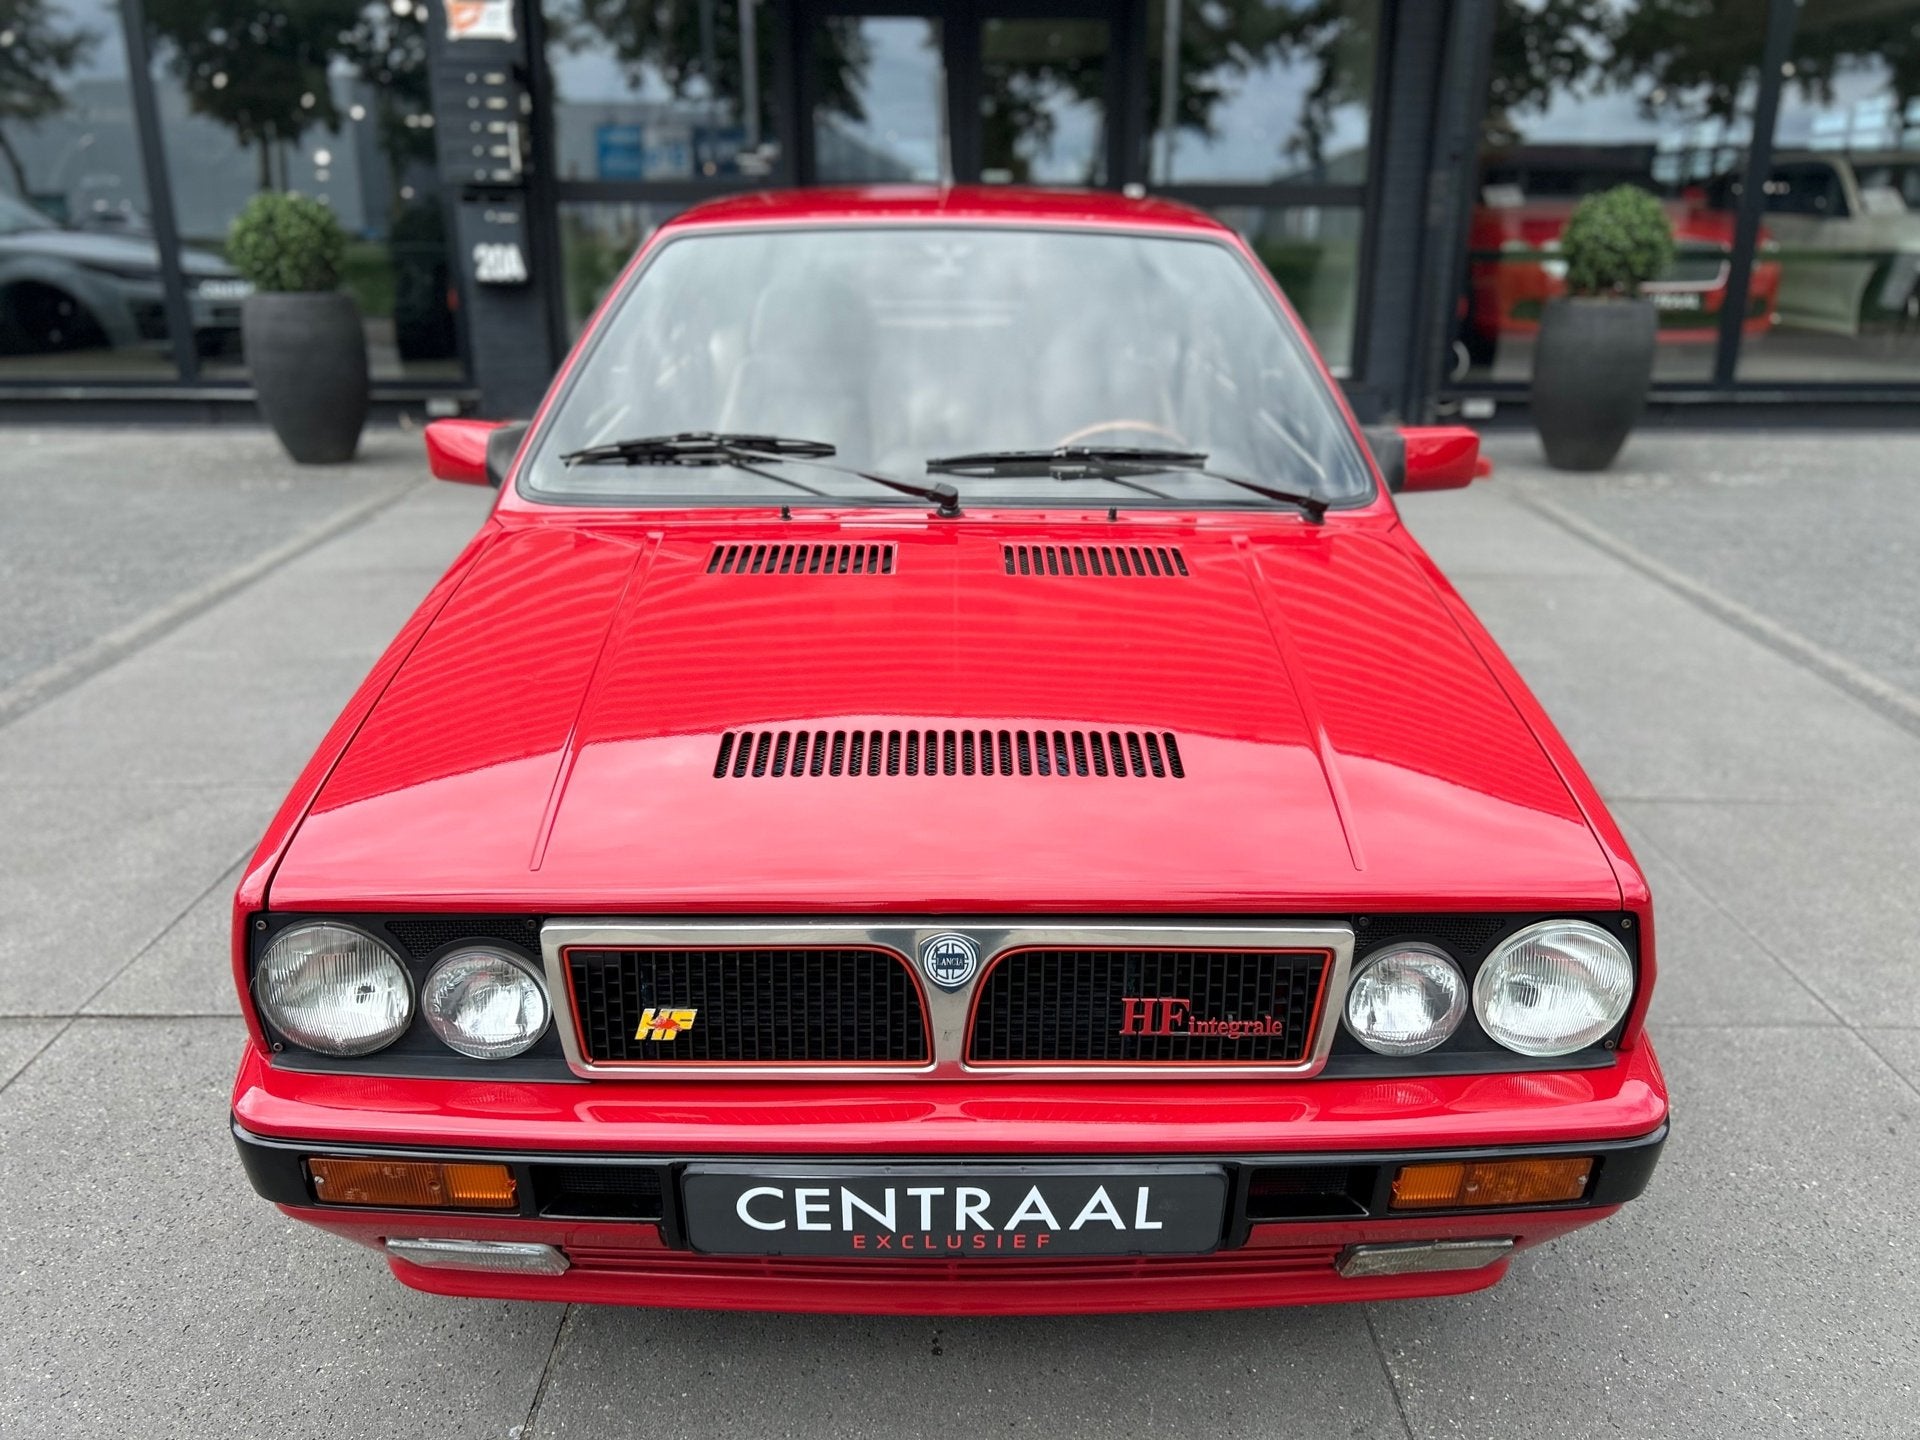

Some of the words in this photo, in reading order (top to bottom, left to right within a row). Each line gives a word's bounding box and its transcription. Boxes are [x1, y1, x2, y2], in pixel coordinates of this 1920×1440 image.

[936, 957, 963, 966] LANCIA
[634, 1008, 698, 1040] HF
[1119, 997, 1190, 1036] HF
[1188, 1015, 1283, 1040] integrale
[736, 1184, 1163, 1232] CENTRAAL
[853, 1233, 1052, 1250] EXCLUSIEF
